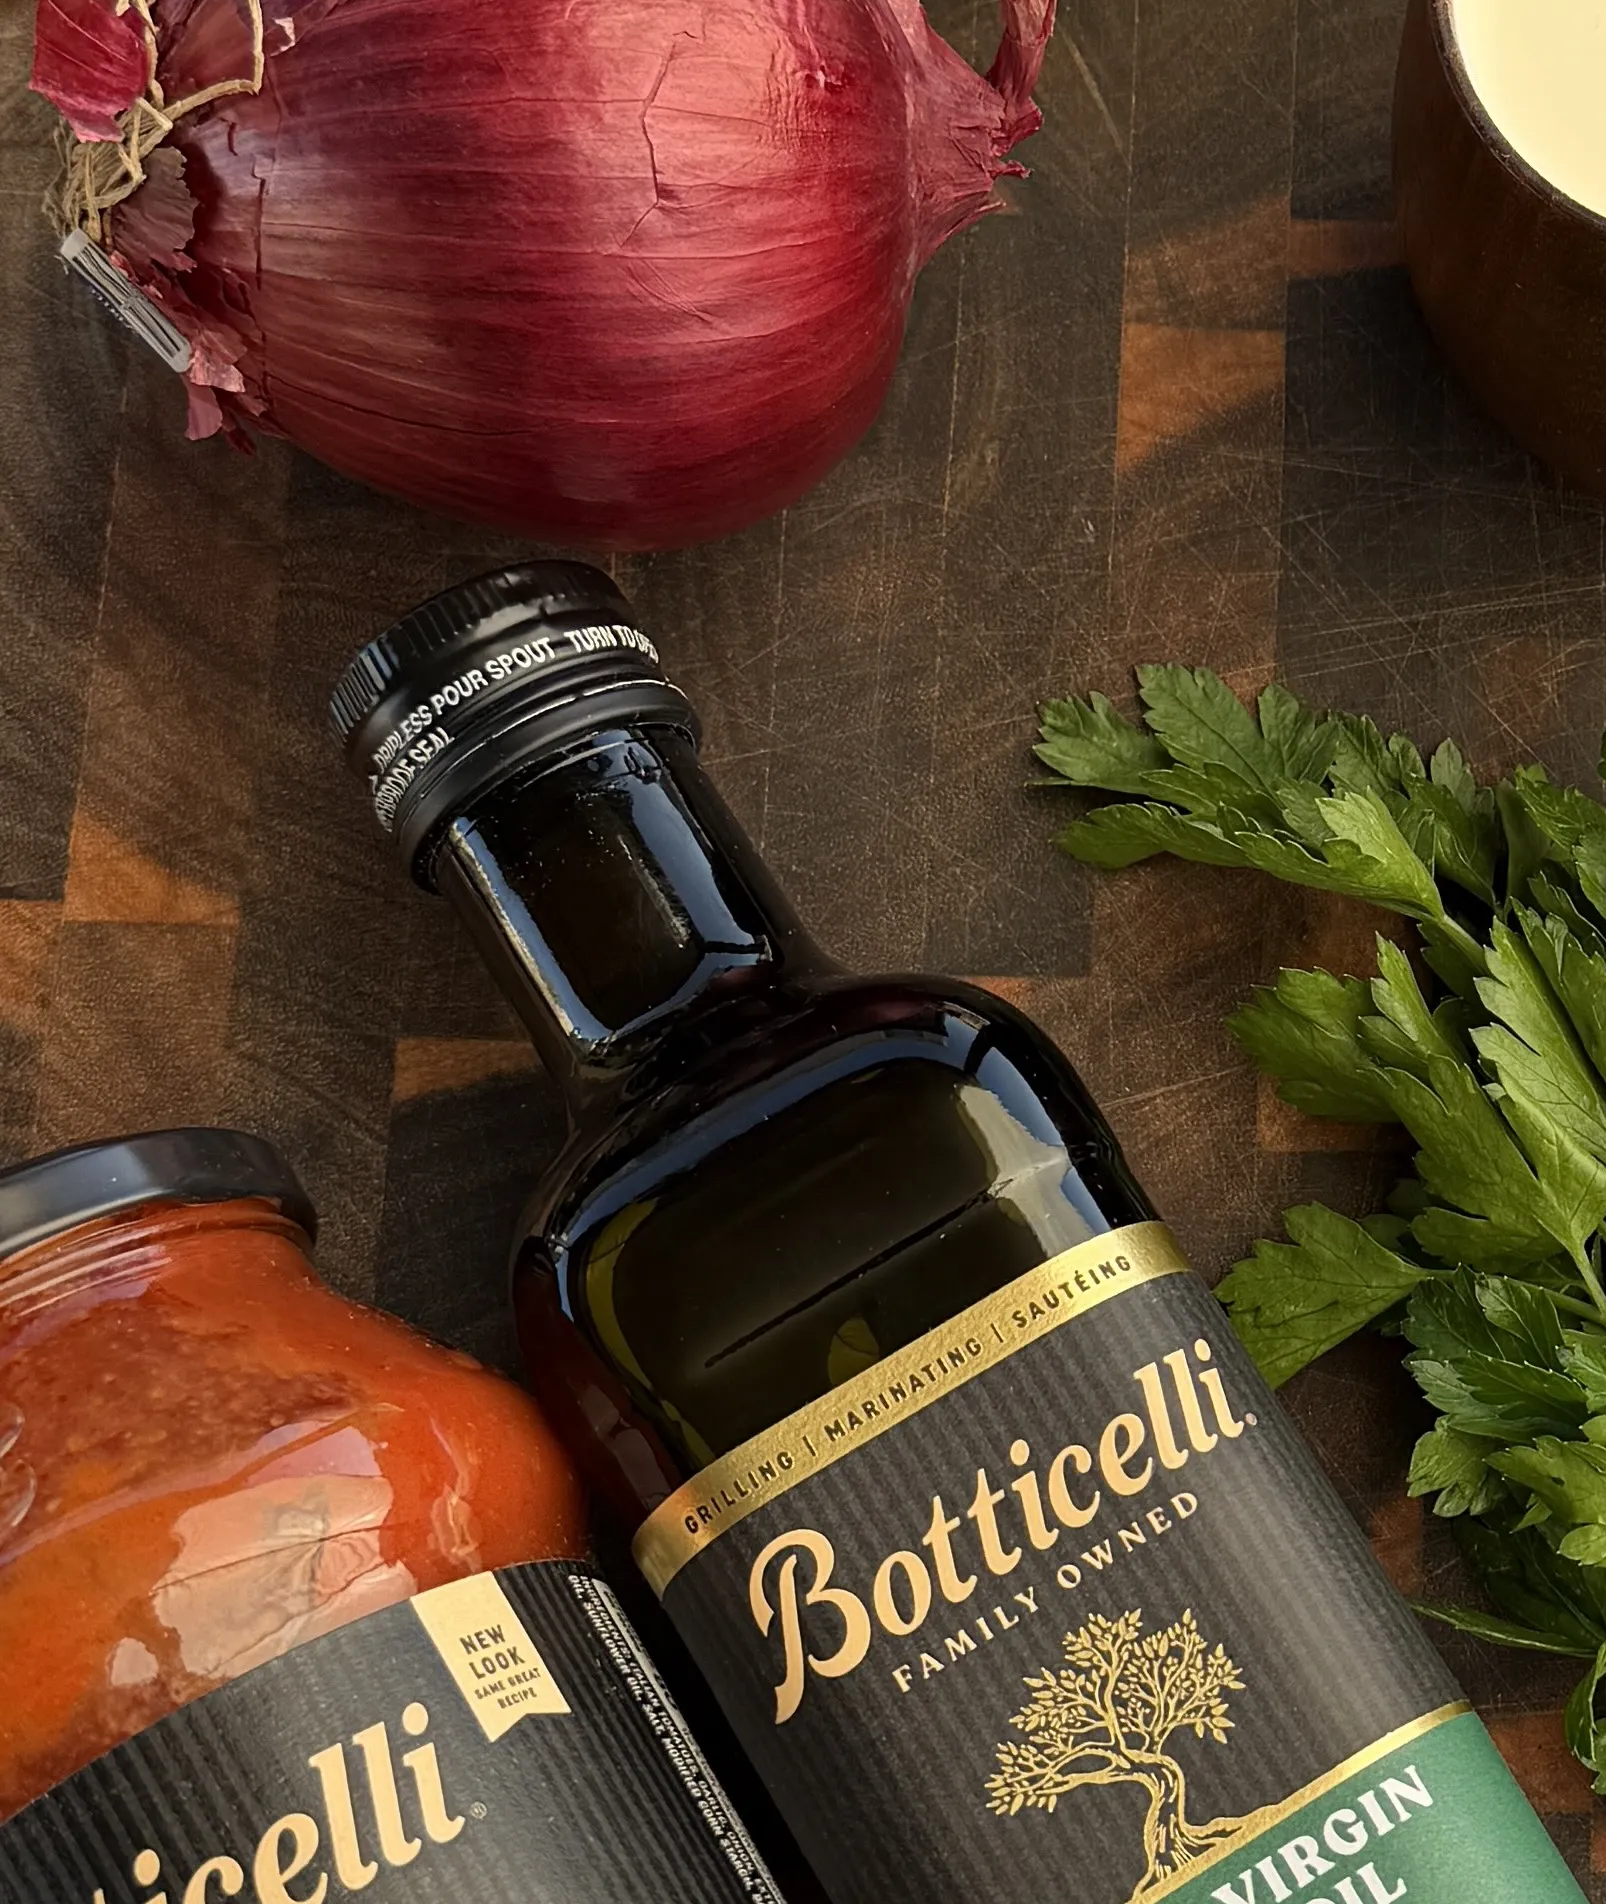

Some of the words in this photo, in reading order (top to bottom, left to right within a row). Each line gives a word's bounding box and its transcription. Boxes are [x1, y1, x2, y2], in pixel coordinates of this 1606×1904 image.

[372, 704, 433, 774] DRIPLESS
[430, 668, 488, 715] POUR
[485, 637, 557, 680] SPOUT
[563, 626, 617, 653] TURN
[612, 625, 636, 648] TO
[409, 726, 455, 770] SEAL
[683, 1451, 793, 1536] GRILLING
[824, 1335, 983, 1444] MARINATING
[1011, 1254, 1132, 1329] SAUTÉING
[748, 1337, 1245, 1725] Botticelli
[891, 1585, 1041, 1694] FAMILY
[1055, 1491, 1199, 1590] OWNED
[459, 1624, 507, 1656] NEW
[468, 1646, 526, 1681] LOOK
[474, 1679, 507, 1701] SAME
[508, 1667, 542, 1689] GREAT
[497, 1686, 539, 1710] RECIPE
[629, 1661, 661, 1708] ITALIAN
[583, 1601, 632, 1676] SUNFLOWER
[660, 1737, 702, 1798] MODIFIED
[697, 1798, 724, 1838] CORN
